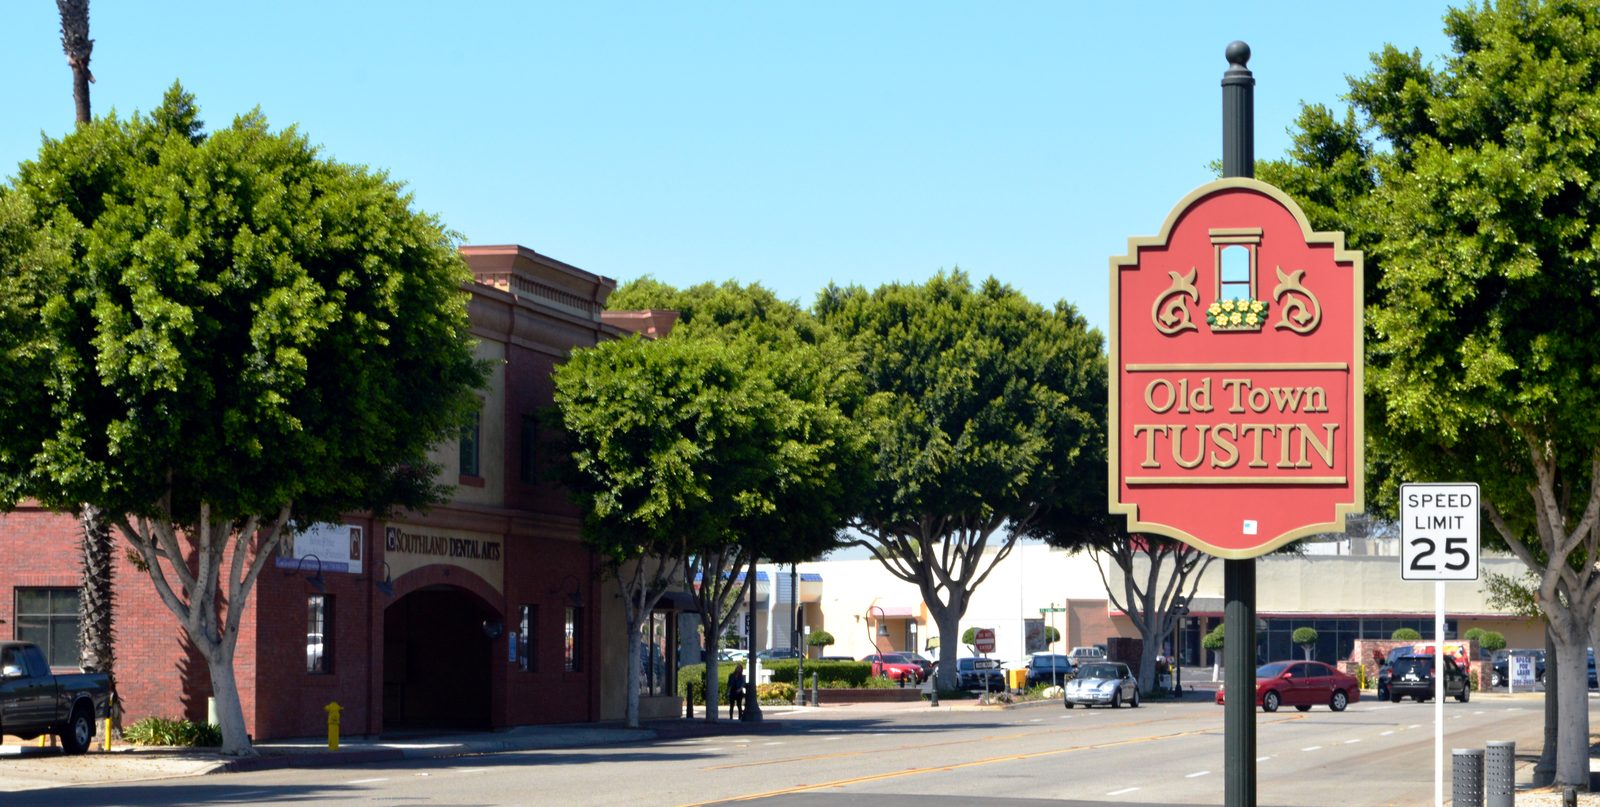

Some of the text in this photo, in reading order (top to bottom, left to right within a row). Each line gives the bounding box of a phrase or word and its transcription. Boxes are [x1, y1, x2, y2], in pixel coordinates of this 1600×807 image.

[1144, 377, 1329, 414] Old Town
[1133, 423, 1340, 470] TUSTIN
[1408, 493, 1472, 508] SPEED
[1415, 516, 1464, 530] LIMIT
[396, 528, 501, 561] SOUTHLAND DENTAL ARTS
[1410, 537, 1470, 571] 25
